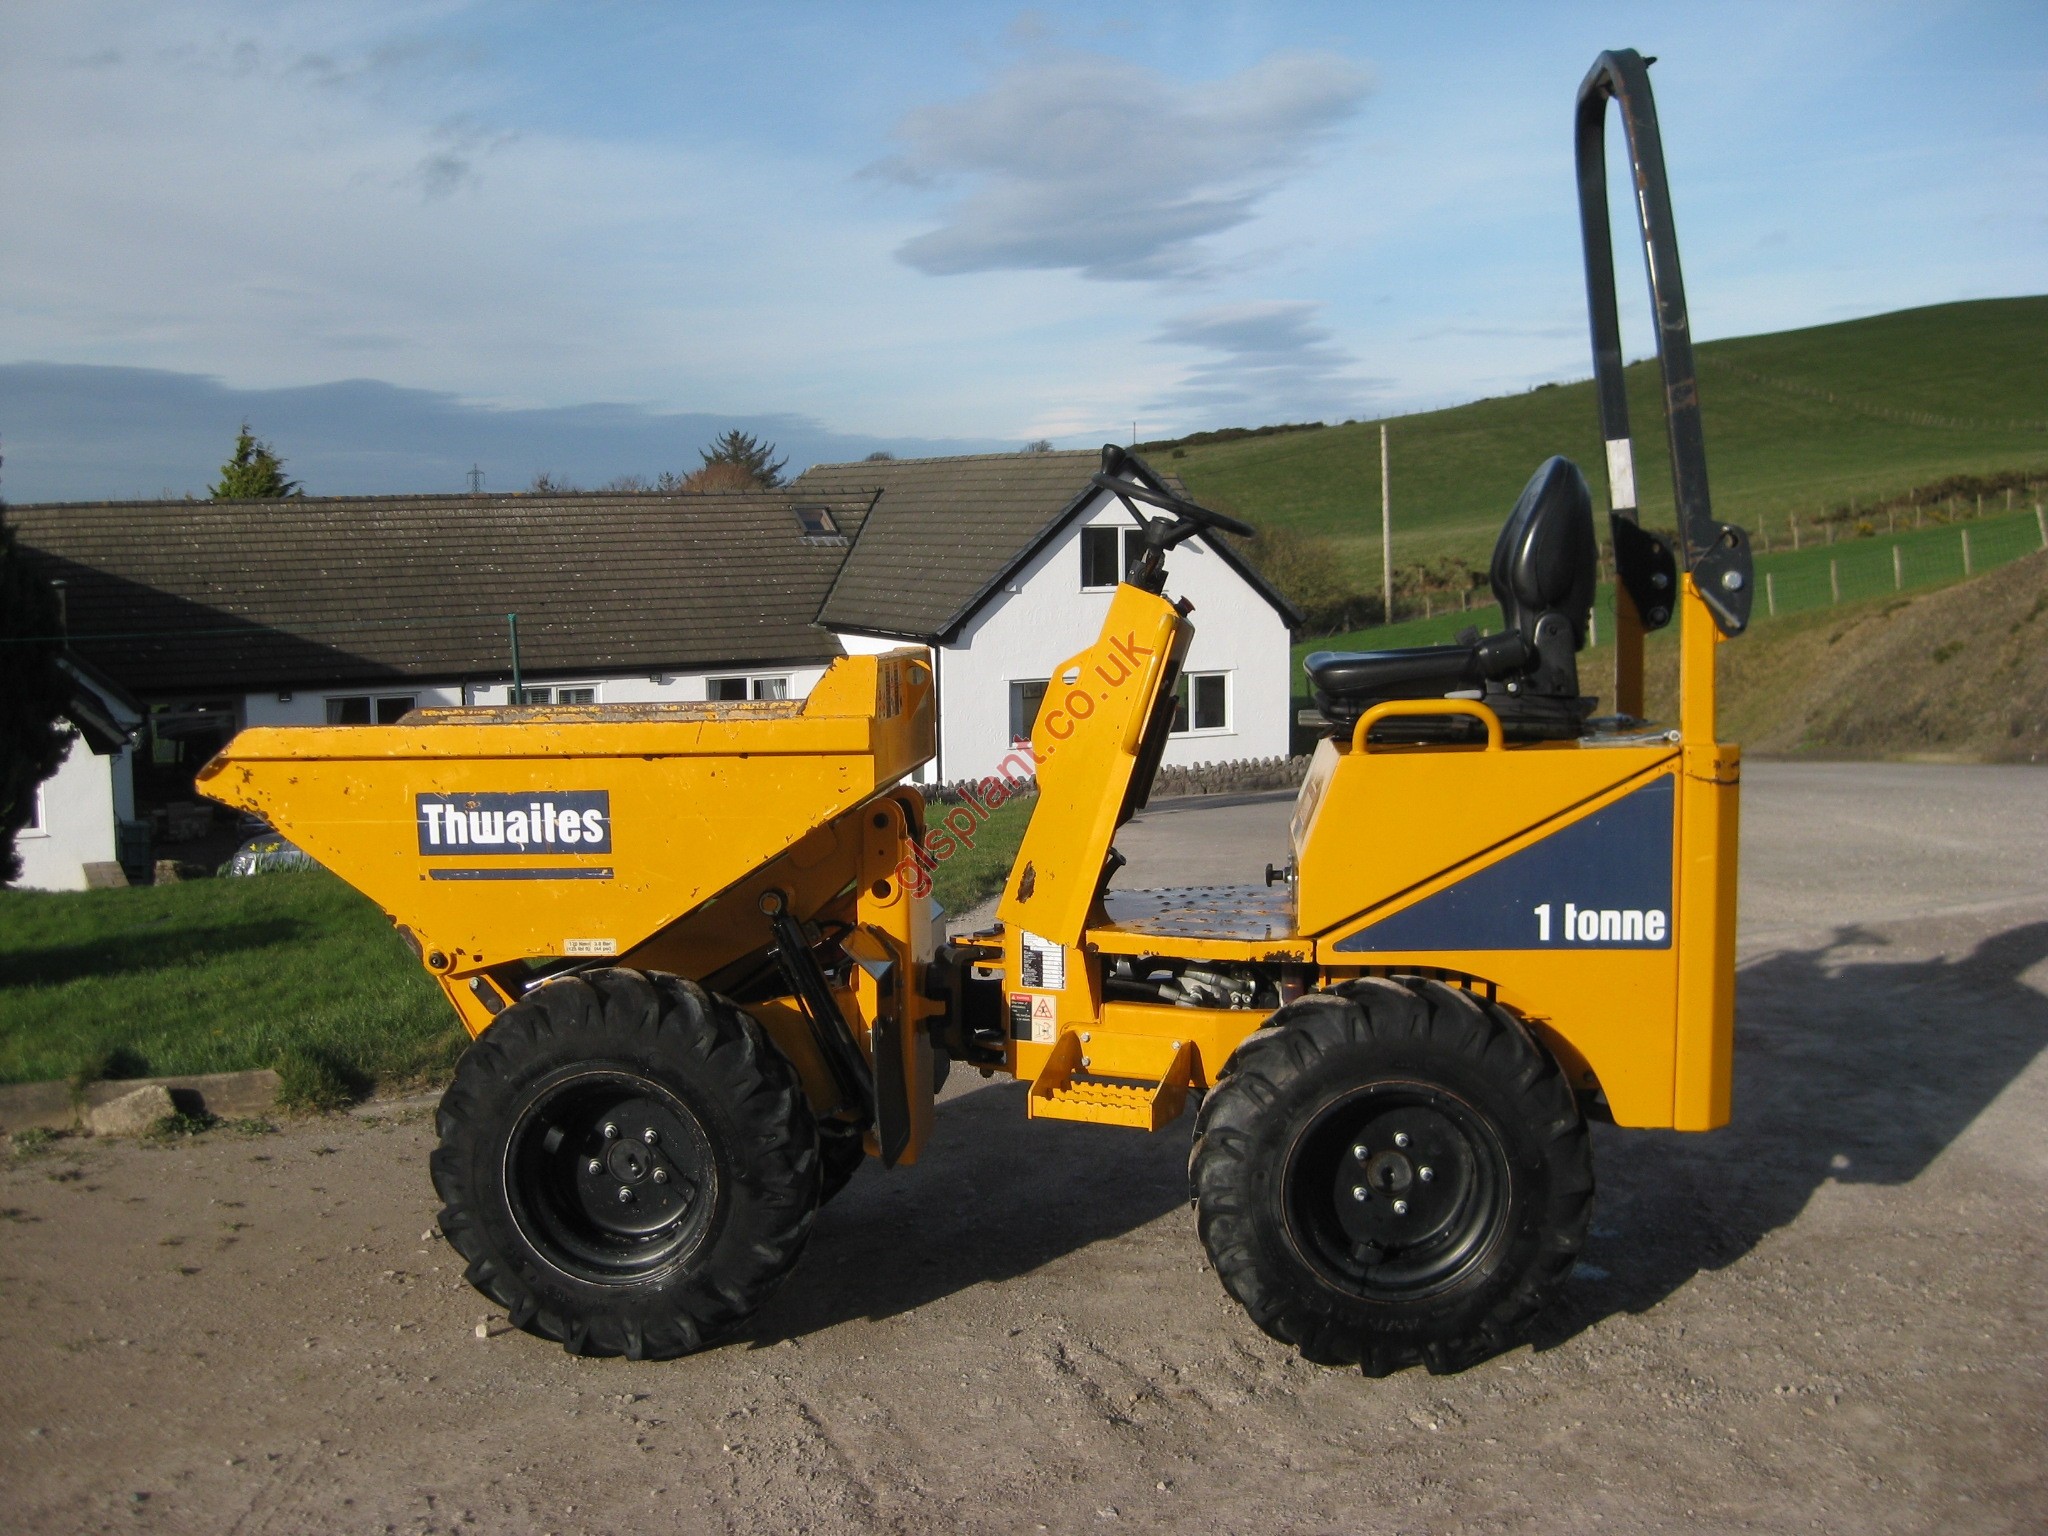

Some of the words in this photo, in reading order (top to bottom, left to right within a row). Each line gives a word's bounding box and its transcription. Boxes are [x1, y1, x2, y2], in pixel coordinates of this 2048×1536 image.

[422, 802, 604, 845] Thwaites
[1533, 903, 1550, 941] 1
[1564, 902, 1666, 941] tonne
